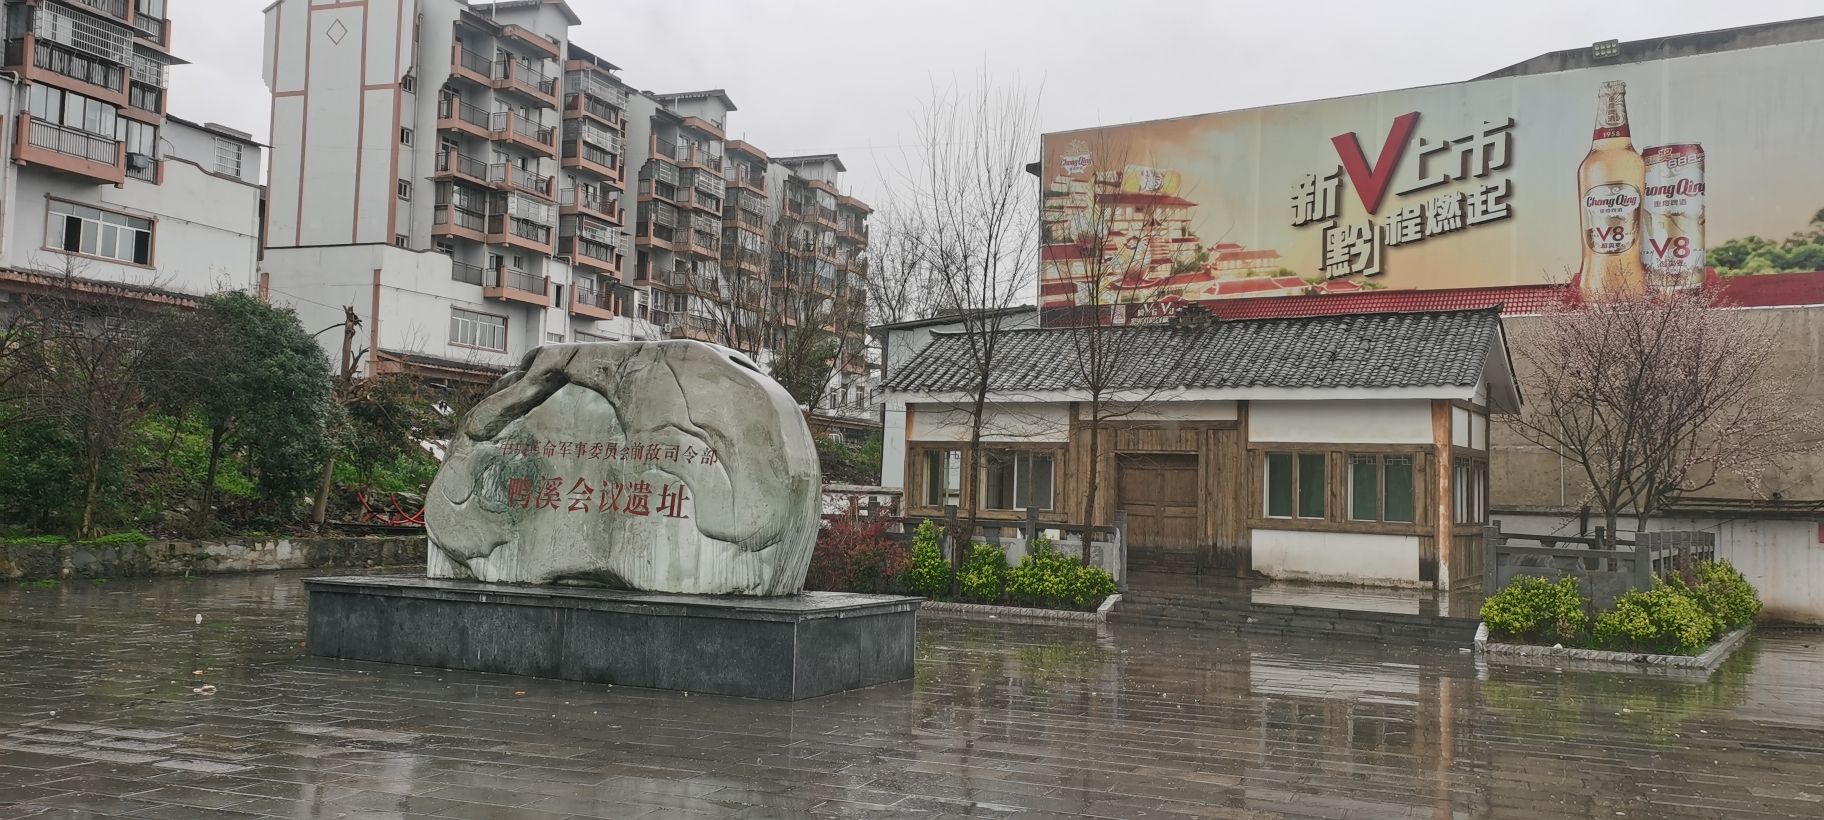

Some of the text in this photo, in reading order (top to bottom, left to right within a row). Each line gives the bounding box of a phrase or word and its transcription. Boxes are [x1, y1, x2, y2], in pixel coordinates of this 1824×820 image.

[1319, 179, 1512, 279] 黔程燃起
[1596, 226, 1624, 241] V8
[1649, 236, 1690, 259] V8
[508, 476, 692, 519] 鸭溪会议遗址
